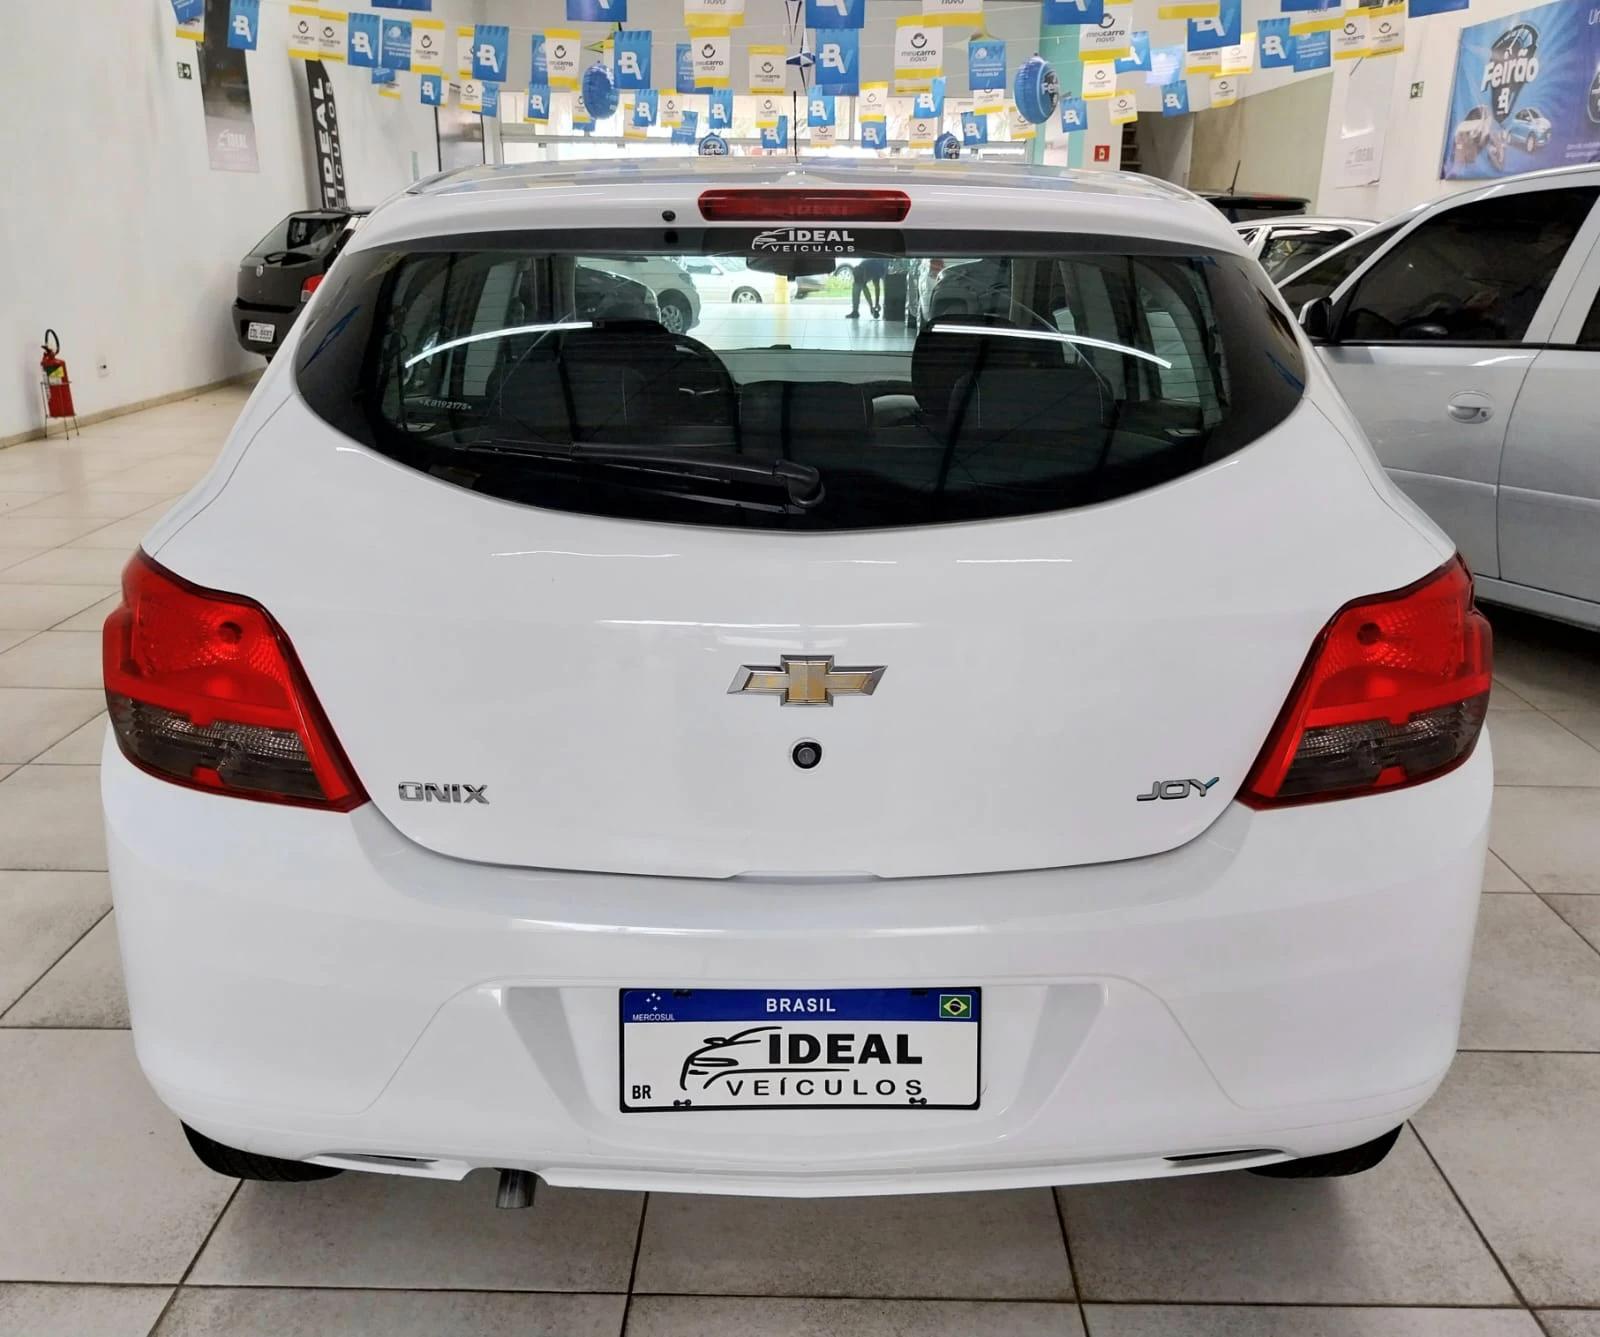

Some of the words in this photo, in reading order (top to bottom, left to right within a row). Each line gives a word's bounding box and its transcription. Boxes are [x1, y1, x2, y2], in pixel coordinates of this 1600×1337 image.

[313, 78, 336, 199] IDEAL
[788, 229, 855, 242] IDEAL
[771, 244, 856, 253] VEÍCULOS
[398, 781, 490, 805] ONIX
[1136, 776, 1220, 802] JOY
[766, 997, 837, 1013] BRASIL
[632, 1013, 676, 1022] MERCOSUL
[768, 1033, 923, 1065] IDEAL
[631, 1084, 652, 1100] BR
[726, 1077, 923, 1097] VEÍCULOS
